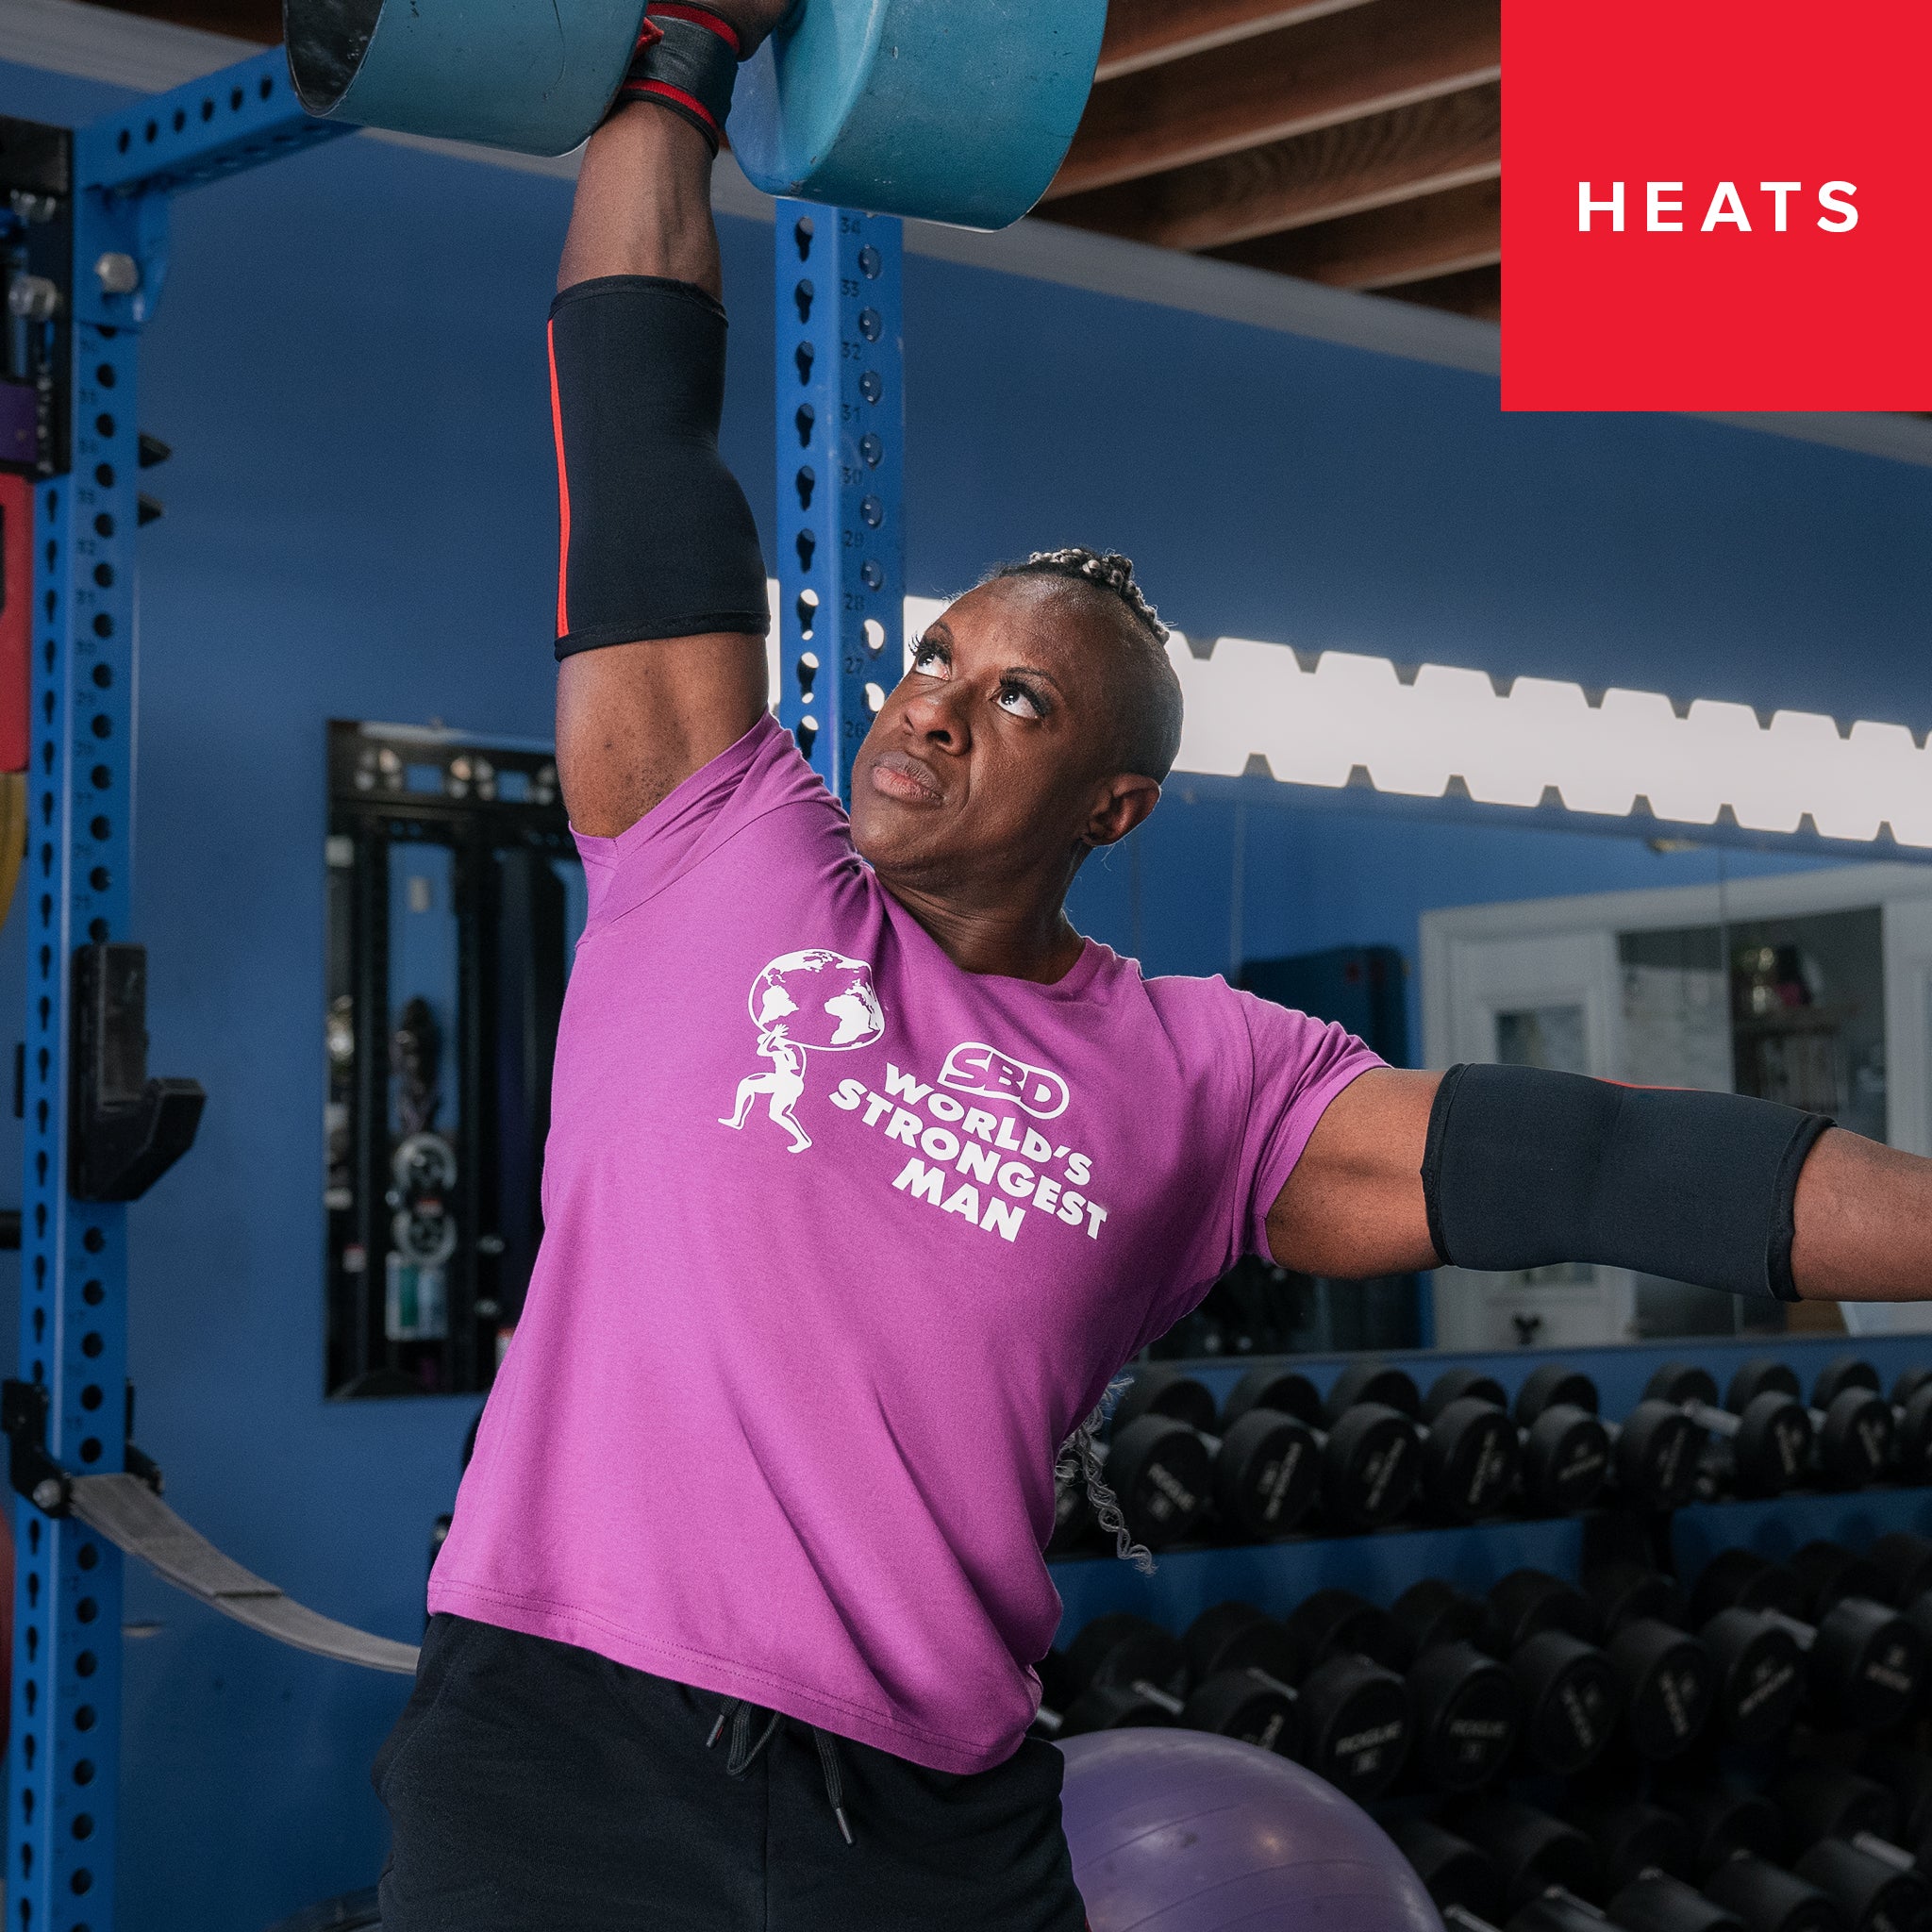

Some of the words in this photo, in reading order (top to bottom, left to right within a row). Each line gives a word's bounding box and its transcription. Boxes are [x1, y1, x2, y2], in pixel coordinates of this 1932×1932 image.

[840, 278, 860, 297] 33
[840, 341, 861, 360] 32
[841, 404, 861, 423] 31
[938, 1041, 1070, 1119] SBD
[828, 1078, 1108, 1241] STRONGEST
[885, 1062, 1092, 1186] WORLD'S
[891, 1157, 1025, 1242] MAN
